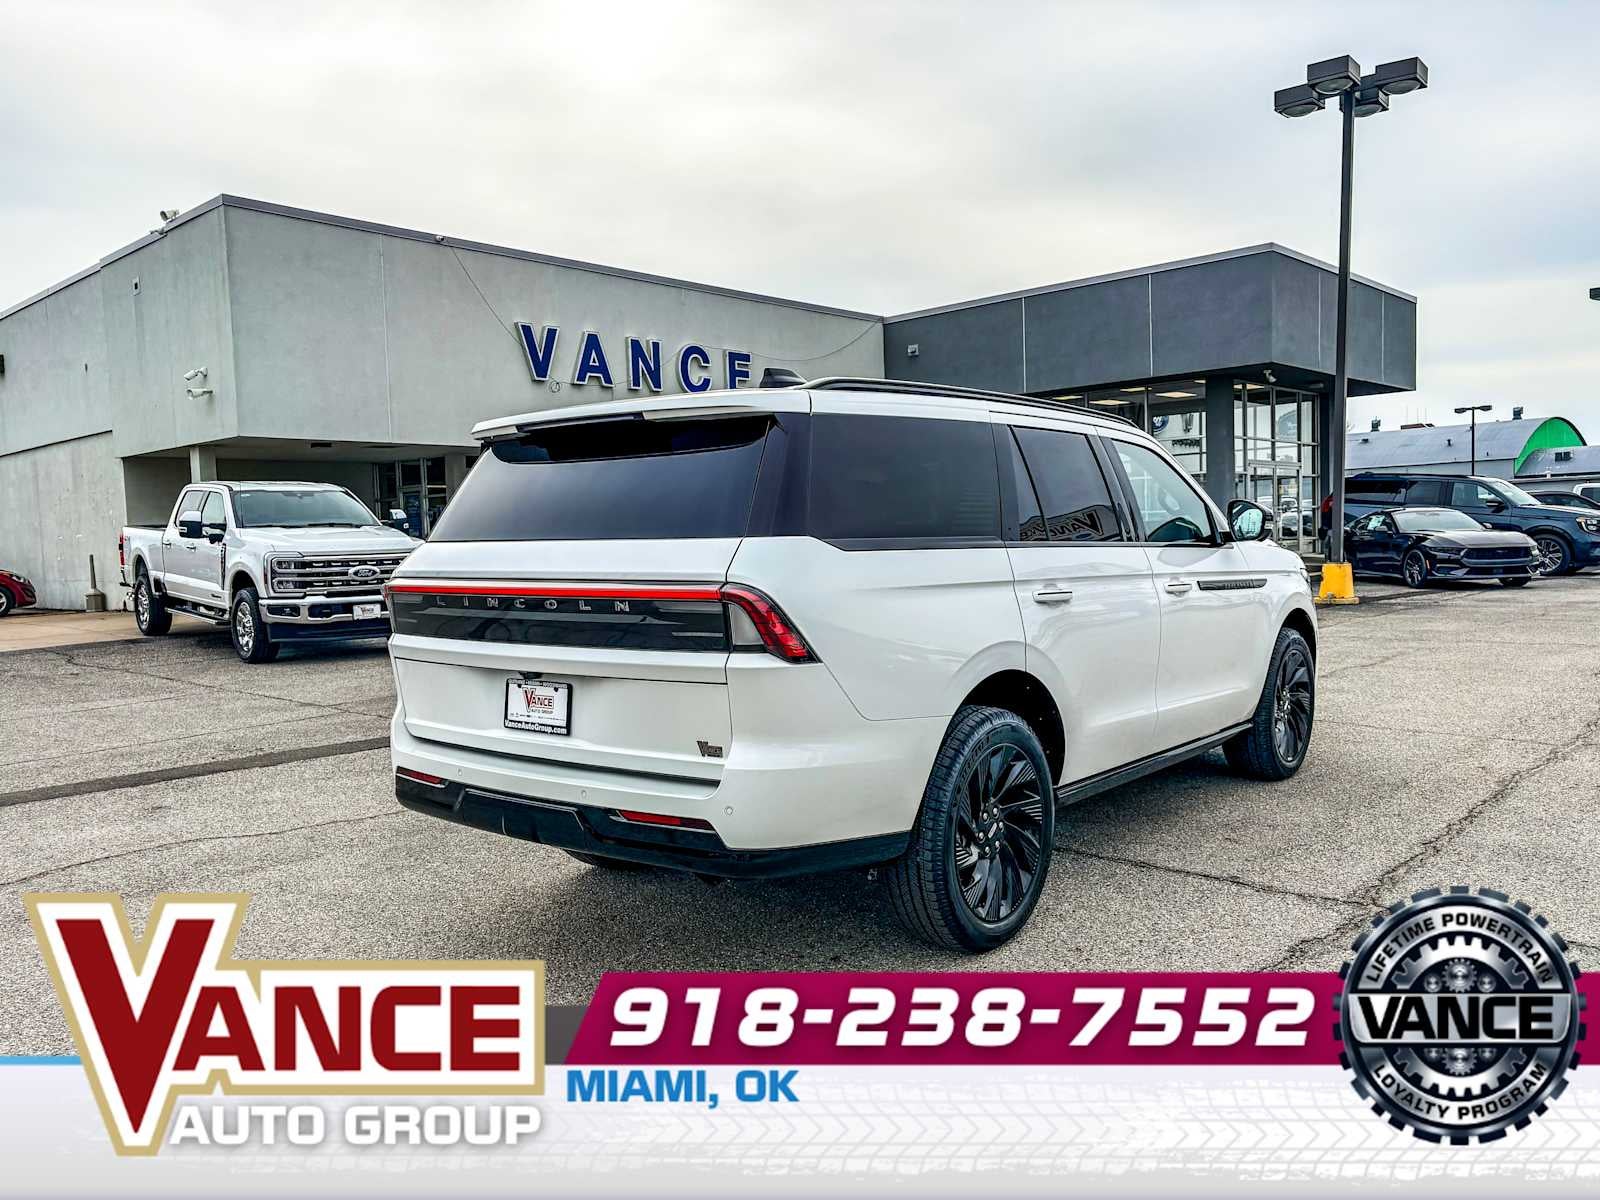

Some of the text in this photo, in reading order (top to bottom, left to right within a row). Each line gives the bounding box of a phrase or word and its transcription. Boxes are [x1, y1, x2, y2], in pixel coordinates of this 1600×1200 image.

[514, 321, 752, 392] VANCE
[436, 596, 630, 612] LINCOLN
[524, 690, 552, 709] VANCE
[504, 719, 567, 734] VanceAutoGroup.com
